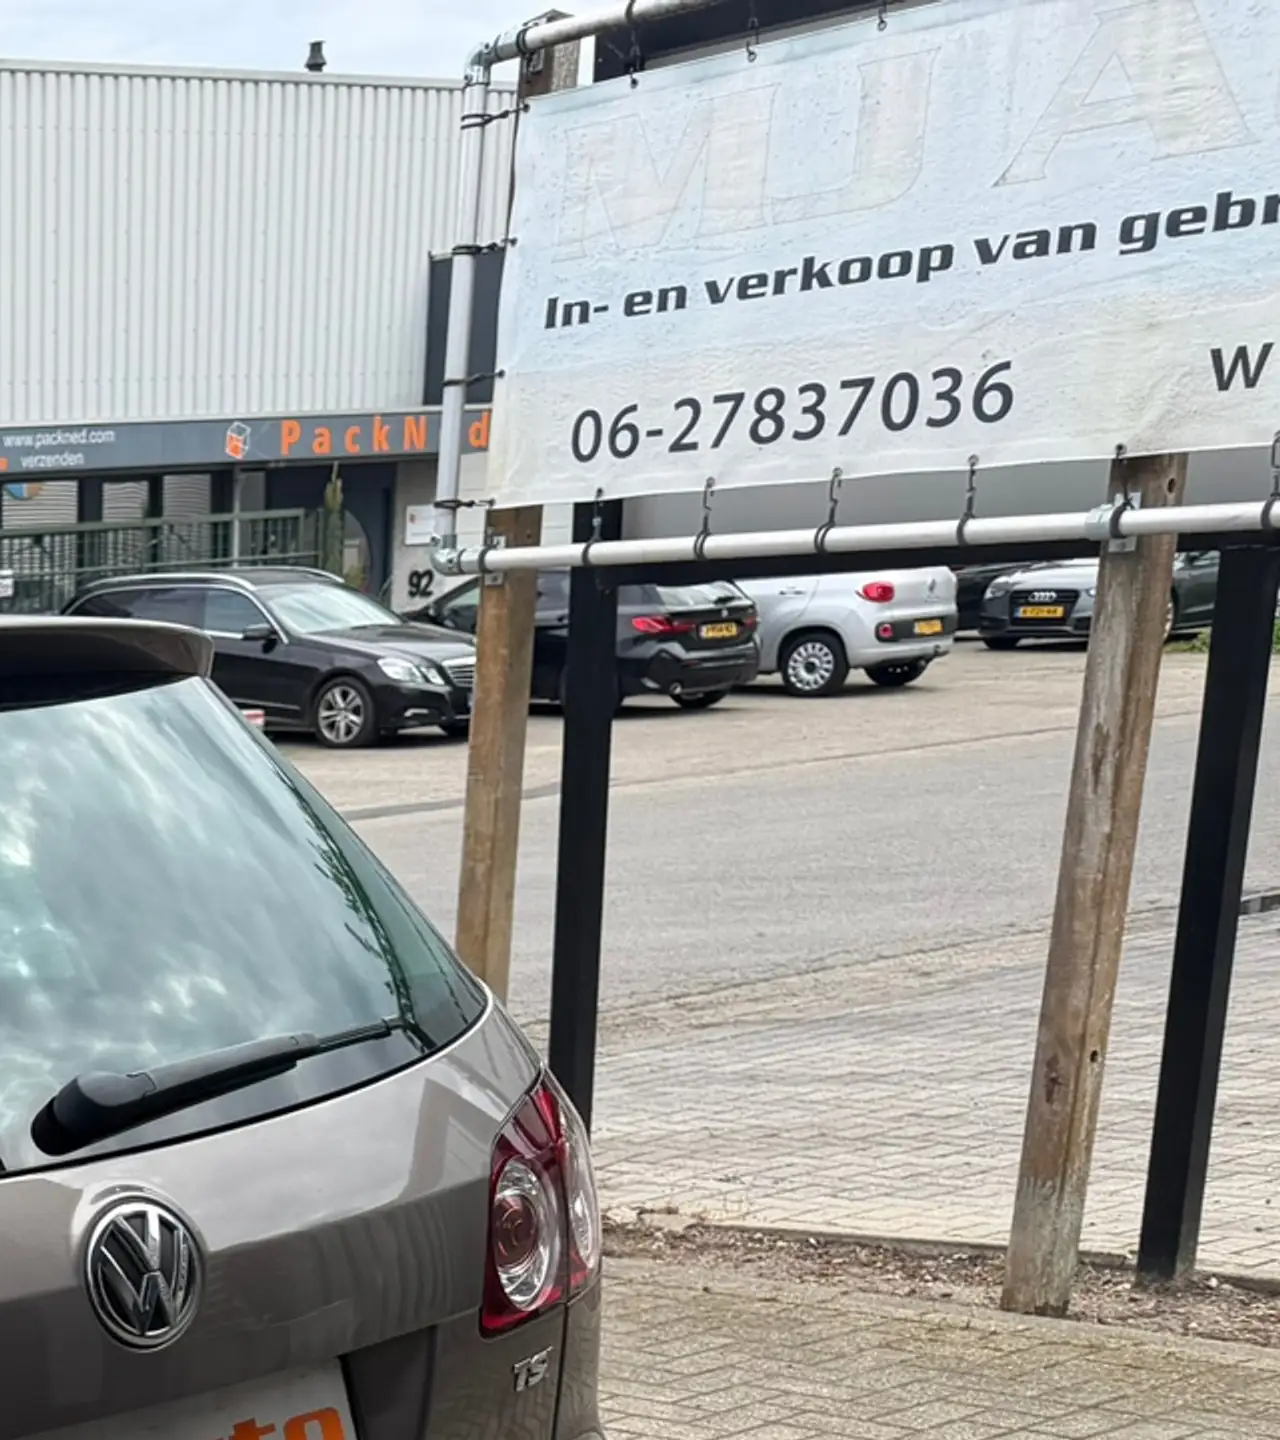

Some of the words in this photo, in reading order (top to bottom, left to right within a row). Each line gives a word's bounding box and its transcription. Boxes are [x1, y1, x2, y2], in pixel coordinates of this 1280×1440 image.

[543, 295, 609, 330] In-
[623, 282, 687, 316] en
[704, 243, 954, 305] verkoop
[973, 221, 1096, 266] van
[571, 360, 1016, 463] 06-27837036
[2, 429, 116, 449] www.packned.com
[280, 410, 491, 457] PackNd
[20, 451, 85, 469] verzenden
[408, 570, 435, 598] 92
